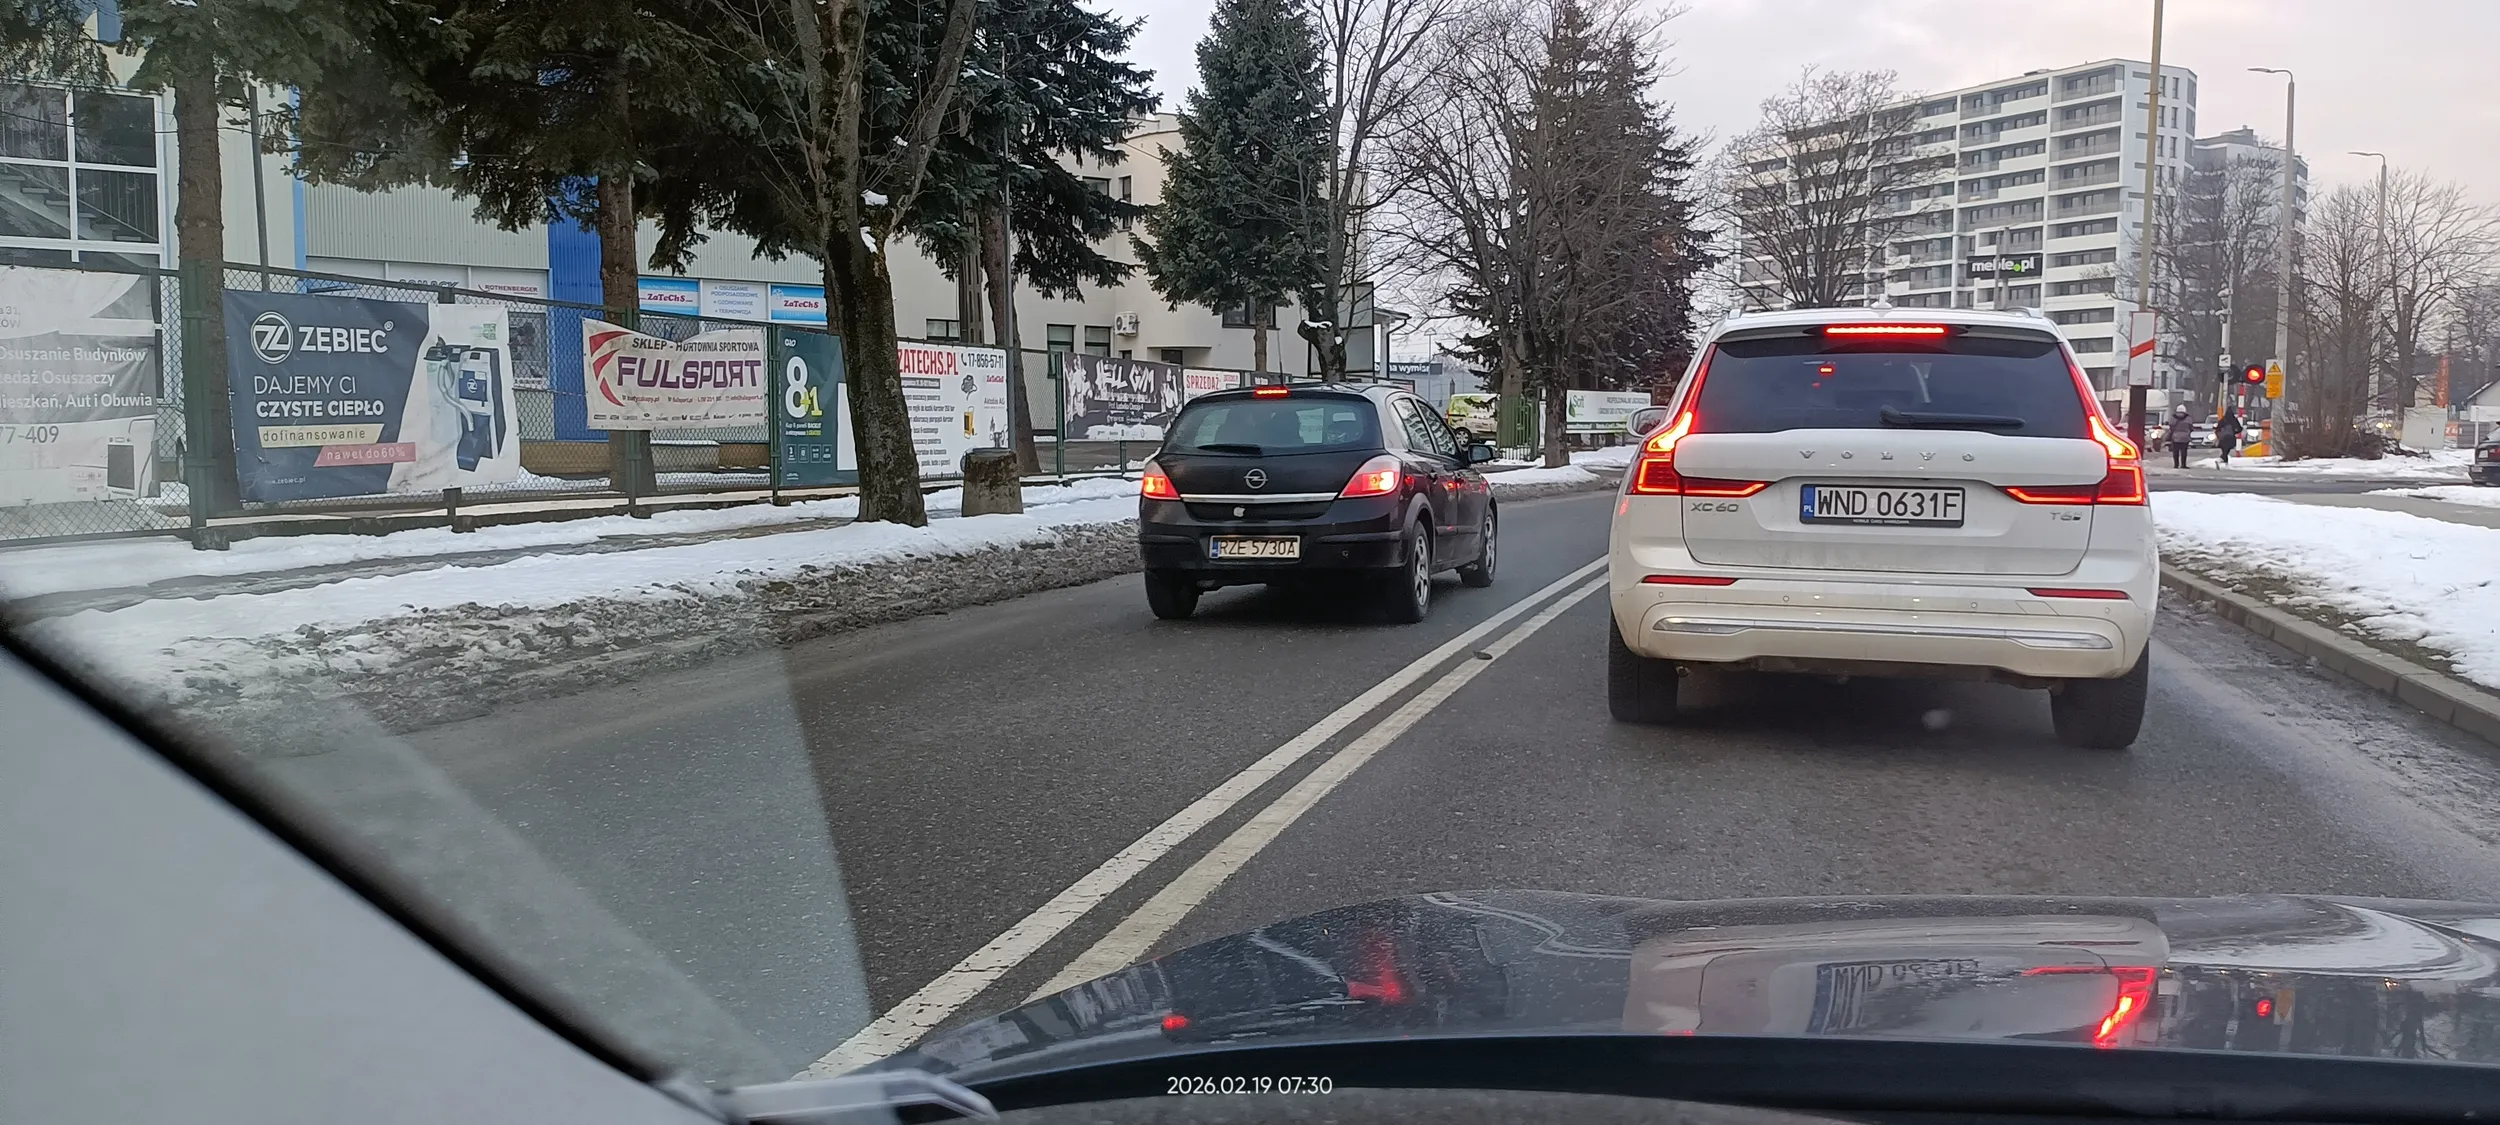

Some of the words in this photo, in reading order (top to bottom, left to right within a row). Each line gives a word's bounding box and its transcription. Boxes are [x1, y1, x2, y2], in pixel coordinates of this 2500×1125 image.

[484, 284, 539, 293] ROTHENBERGER
[648, 293, 686, 303] ZaTeChS
[783, 299, 820, 309] ZaTeChS
[632, 337, 667, 351] SKLEP
[719, 341, 760, 352] SPORTOWA
[74, 347, 147, 363] Budynków
[42, 370, 115, 387] Osuszaczy
[617, 356, 762, 389] FULSPORT
[254, 376, 334, 394] DAJEMY
[339, 377, 356, 394] CI
[65, 394, 91, 408] Aut
[94, 393, 98, 407] i
[100, 393, 153, 407] Obuwia
[256, 401, 323, 418] CZYSTE
[327, 400, 384, 416] CIEPŁO
[262, 429, 366, 442] dofinansowanie
[327, 449, 363, 461] nawet
[1799, 450, 1975, 463] VOLVO
[1803, 505, 1813, 513] PL
[1817, 489, 1867, 516] WND
[1877, 491, 1961, 518] 0631F
[1219, 540, 1247, 556] RZE
[1251, 540, 1296, 556] 5730A
